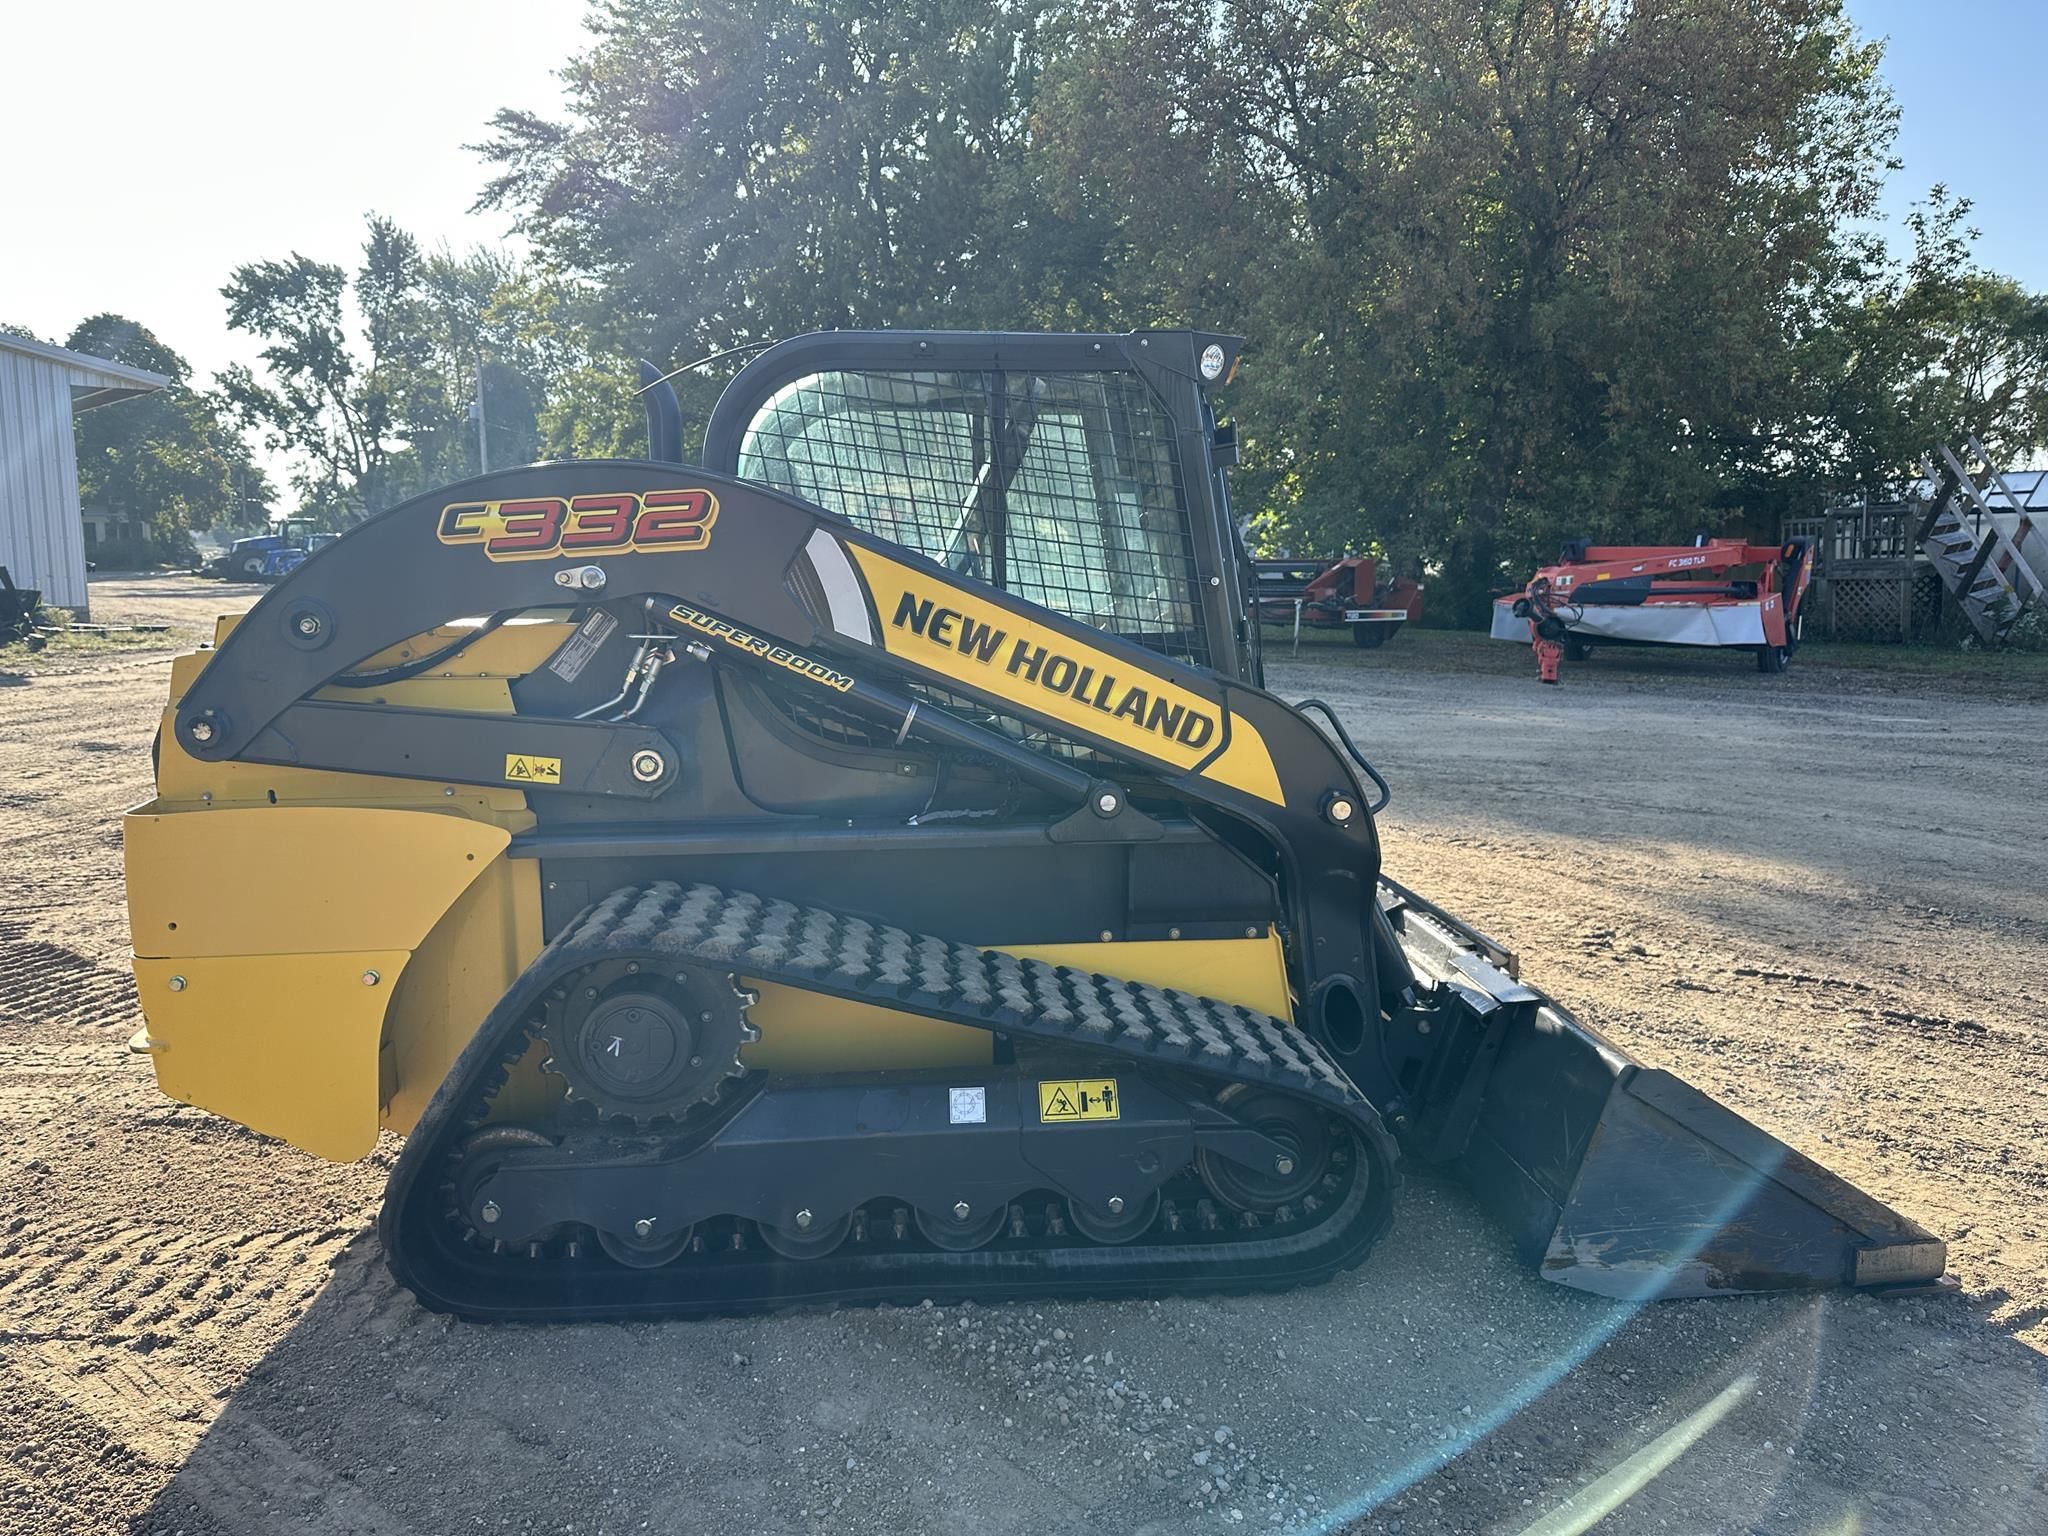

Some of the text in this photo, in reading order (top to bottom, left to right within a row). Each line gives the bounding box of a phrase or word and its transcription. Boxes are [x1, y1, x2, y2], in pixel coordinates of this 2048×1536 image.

[438, 489, 719, 562] C332
[669, 604, 770, 657] SUPER
[767, 646, 855, 693] BOOM
[892, 591, 1215, 749] NEW HOLLAND
